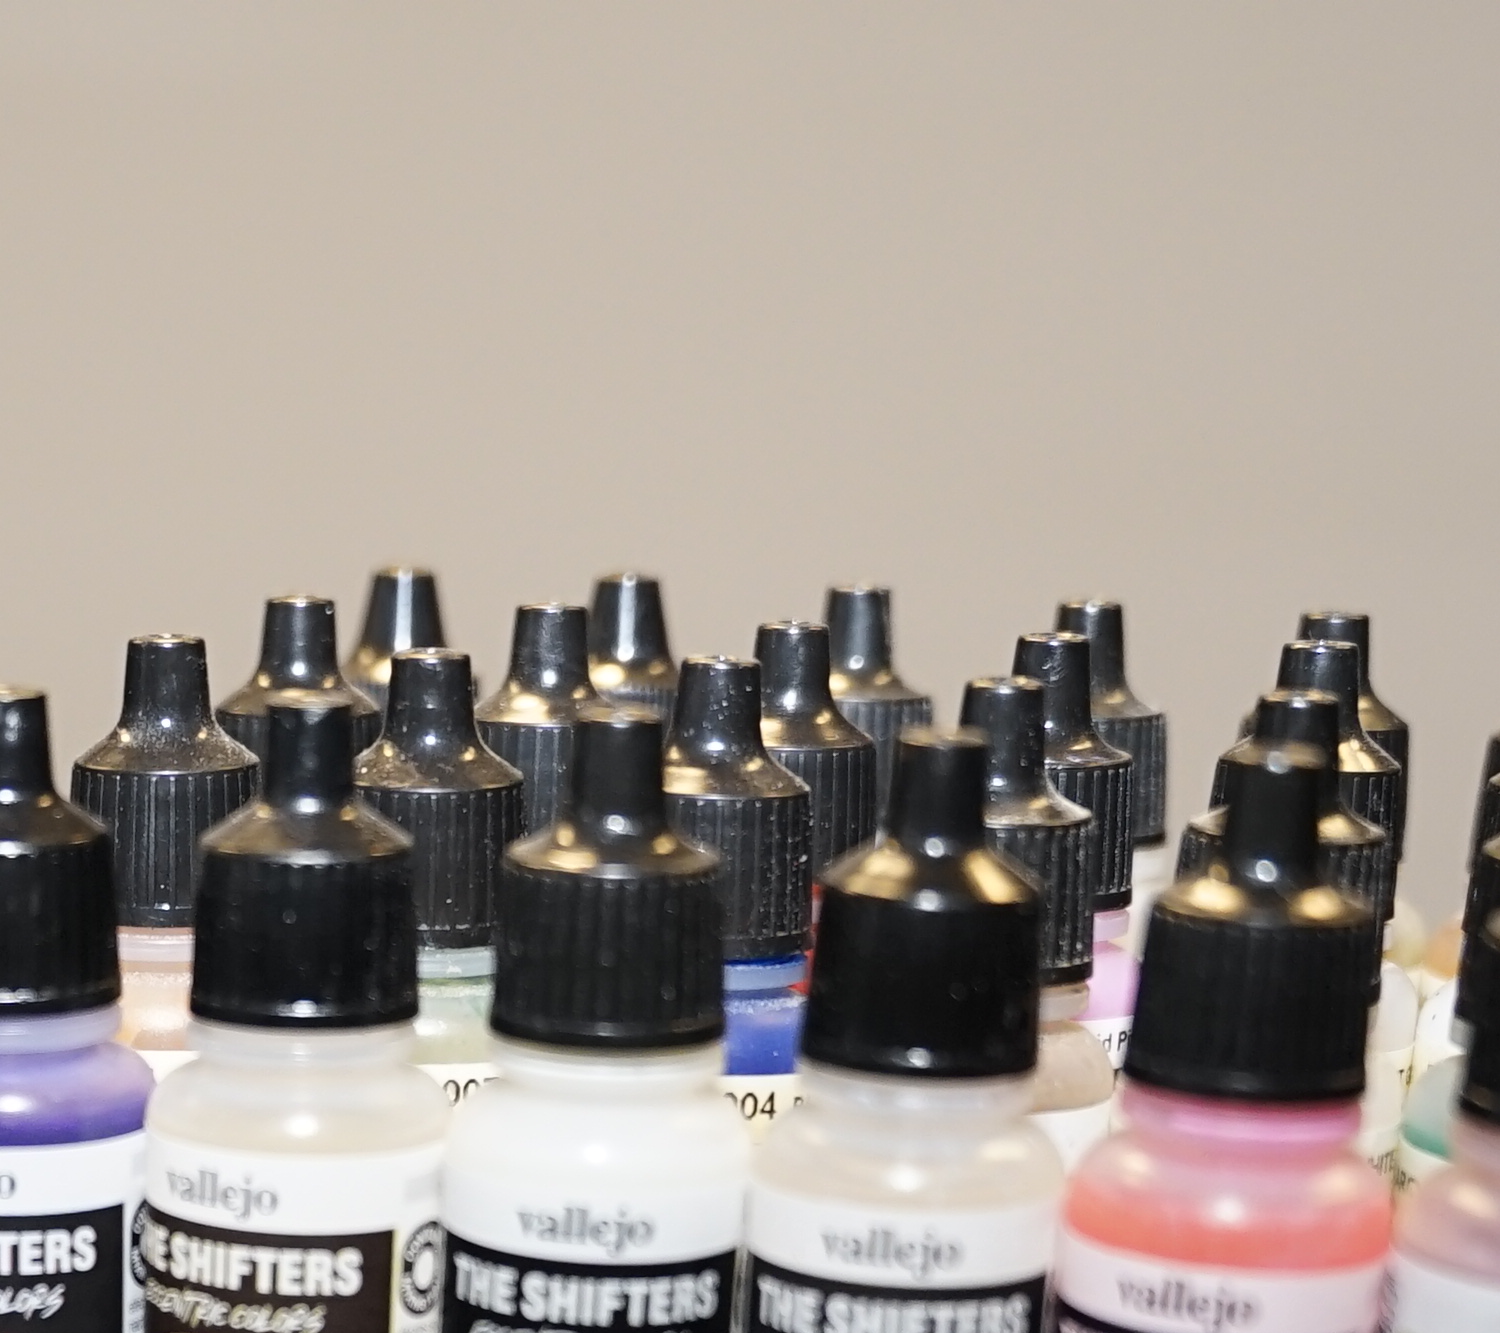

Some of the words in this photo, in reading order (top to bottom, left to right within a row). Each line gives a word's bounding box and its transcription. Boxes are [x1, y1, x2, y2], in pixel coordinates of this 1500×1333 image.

[166, 1167, 279, 1221] vallejo
[518, 1206, 655, 1258] vallejo
[822, 1228, 964, 1280] vallejo
[170, 1235, 363, 1297] SHIFTERS
[454, 1252, 518, 1316] THE
[520, 1268, 721, 1328] SHIFTERS
